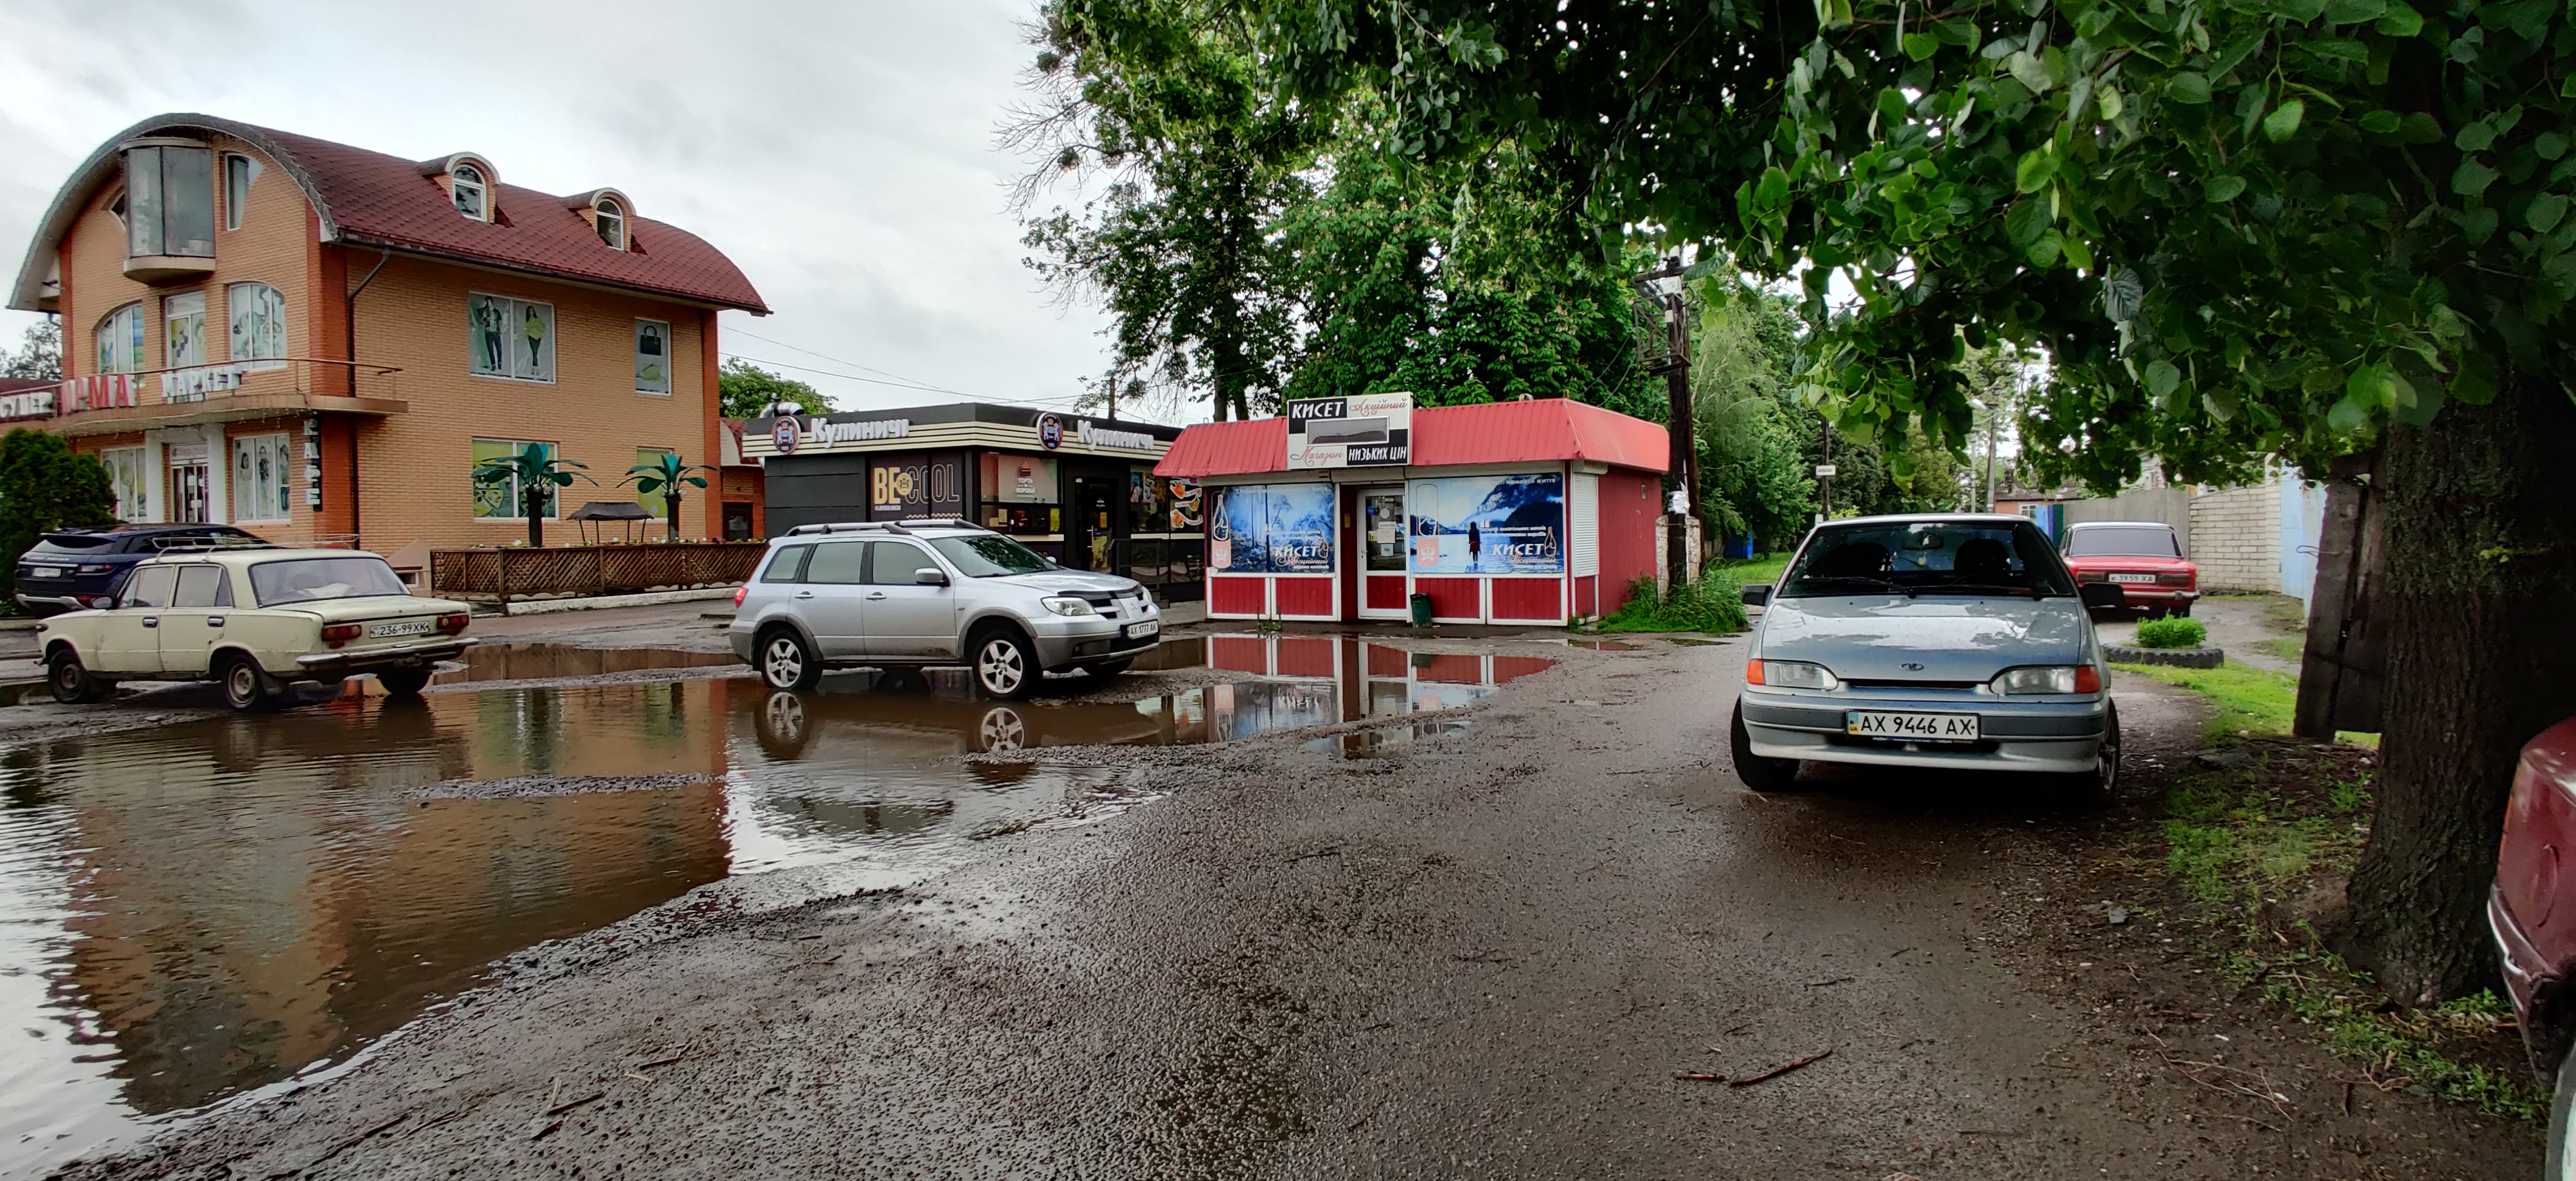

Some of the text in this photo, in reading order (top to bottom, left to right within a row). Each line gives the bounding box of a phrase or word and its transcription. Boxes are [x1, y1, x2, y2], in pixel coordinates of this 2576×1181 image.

[162, 365, 240, 398] МАРКЕТ
[1292, 401, 1344, 418] КИСЕТ
[1349, 398, 1408, 417] Акційний
[1290, 447, 1344, 466] Магазин
[1348, 446, 1407, 461] НИЗЬКИХ ЦІН
[874, 464, 960, 504] BE COOL
[1275, 545, 1319, 557] КИСЕТ
[1493, 544, 1544, 555] КИСЕТ
[380, 624, 413, 636] 236-99
[1131, 626, 1138, 635] AX
[1150, 622, 1157, 632] AK
[1860, 715, 1972, 735] AX 9446 AX
